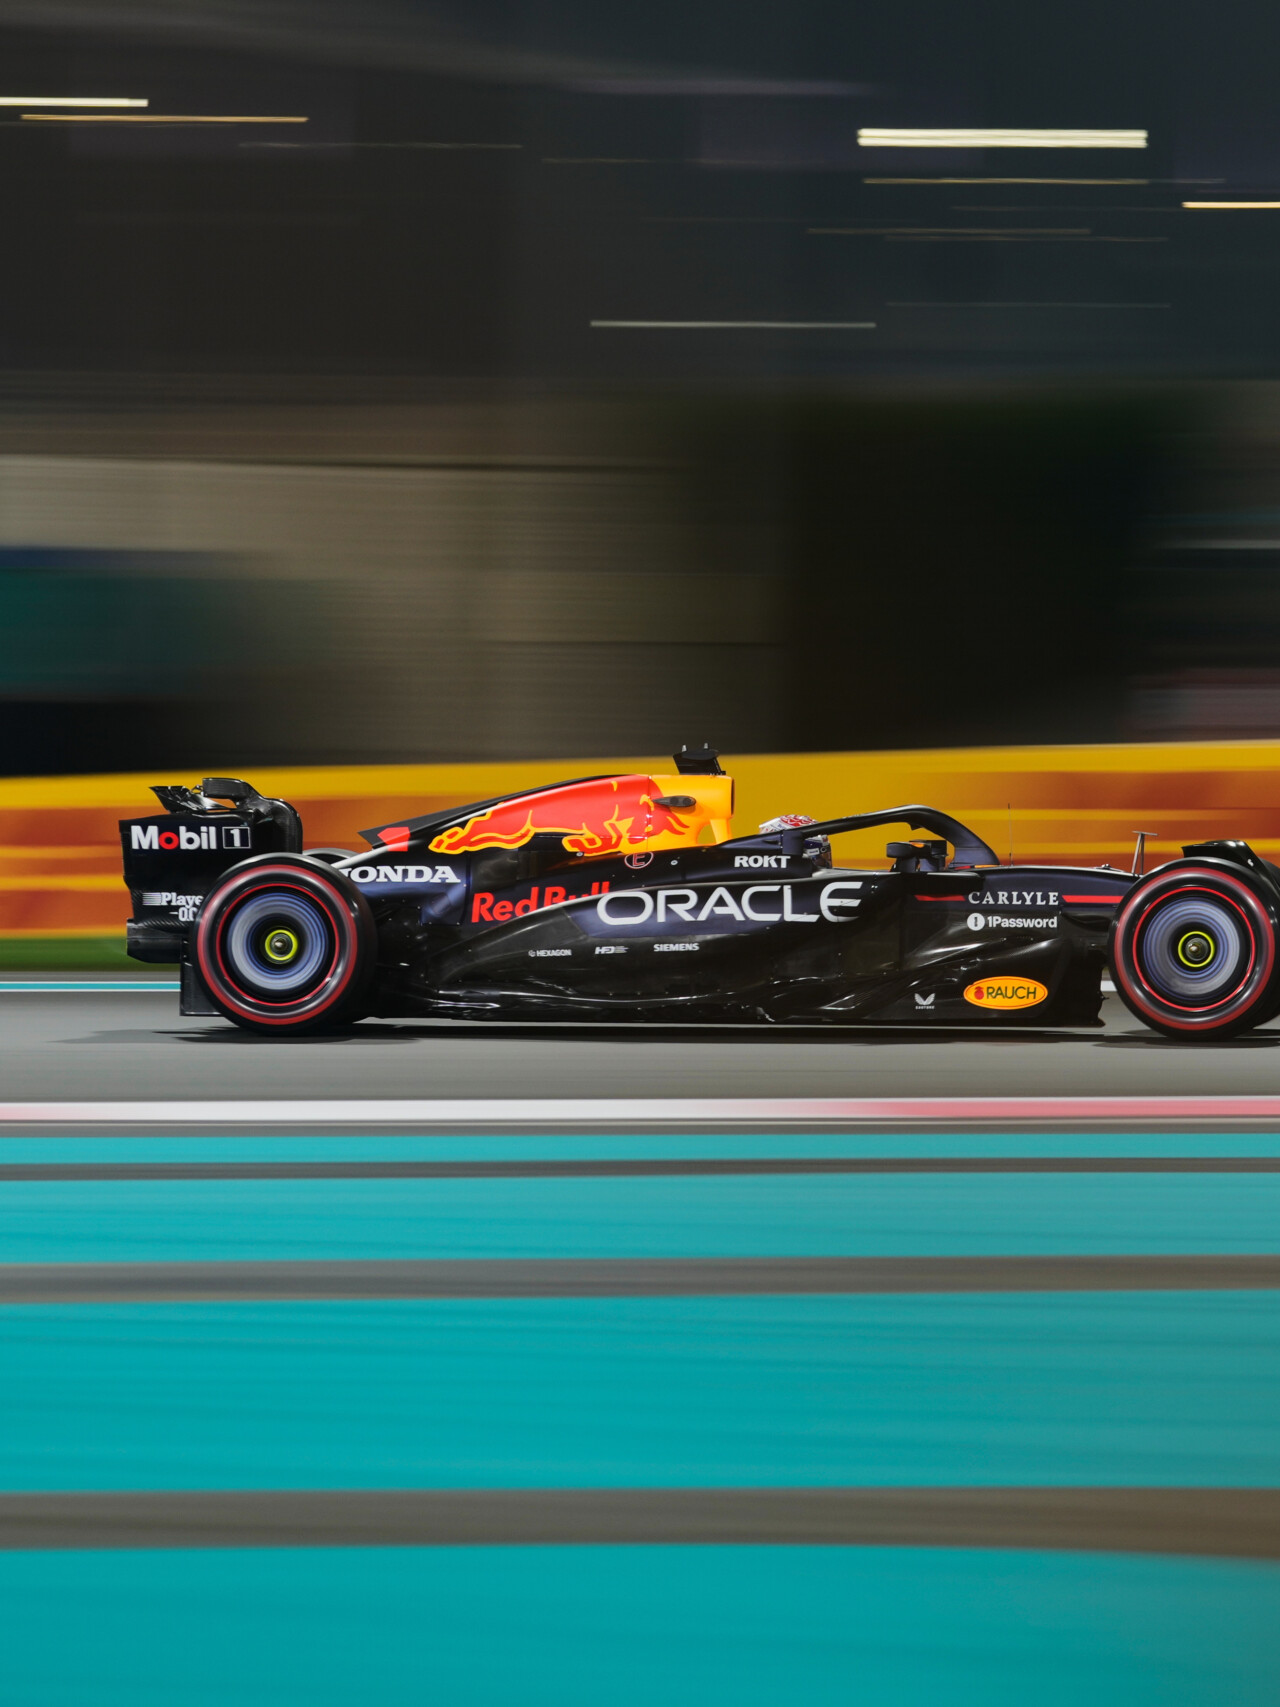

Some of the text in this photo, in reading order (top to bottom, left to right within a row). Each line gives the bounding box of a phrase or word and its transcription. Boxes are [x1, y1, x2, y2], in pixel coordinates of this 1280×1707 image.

[131, 825, 217, 850] Mobil
[734, 855, 791, 868] ROKT
[339, 865, 461, 883] ONDA
[160, 892, 204, 908] Playe
[471, 886, 540, 923] Red
[596, 881, 864, 926] ORACLE
[968, 890, 1059, 905] CARLYLE
[987, 915, 1058, 928] 1Password
[536, 949, 572, 957] HEXAGON
[653, 942, 700, 954] SIEMENS
[986, 986, 1037, 999] RAUCH
